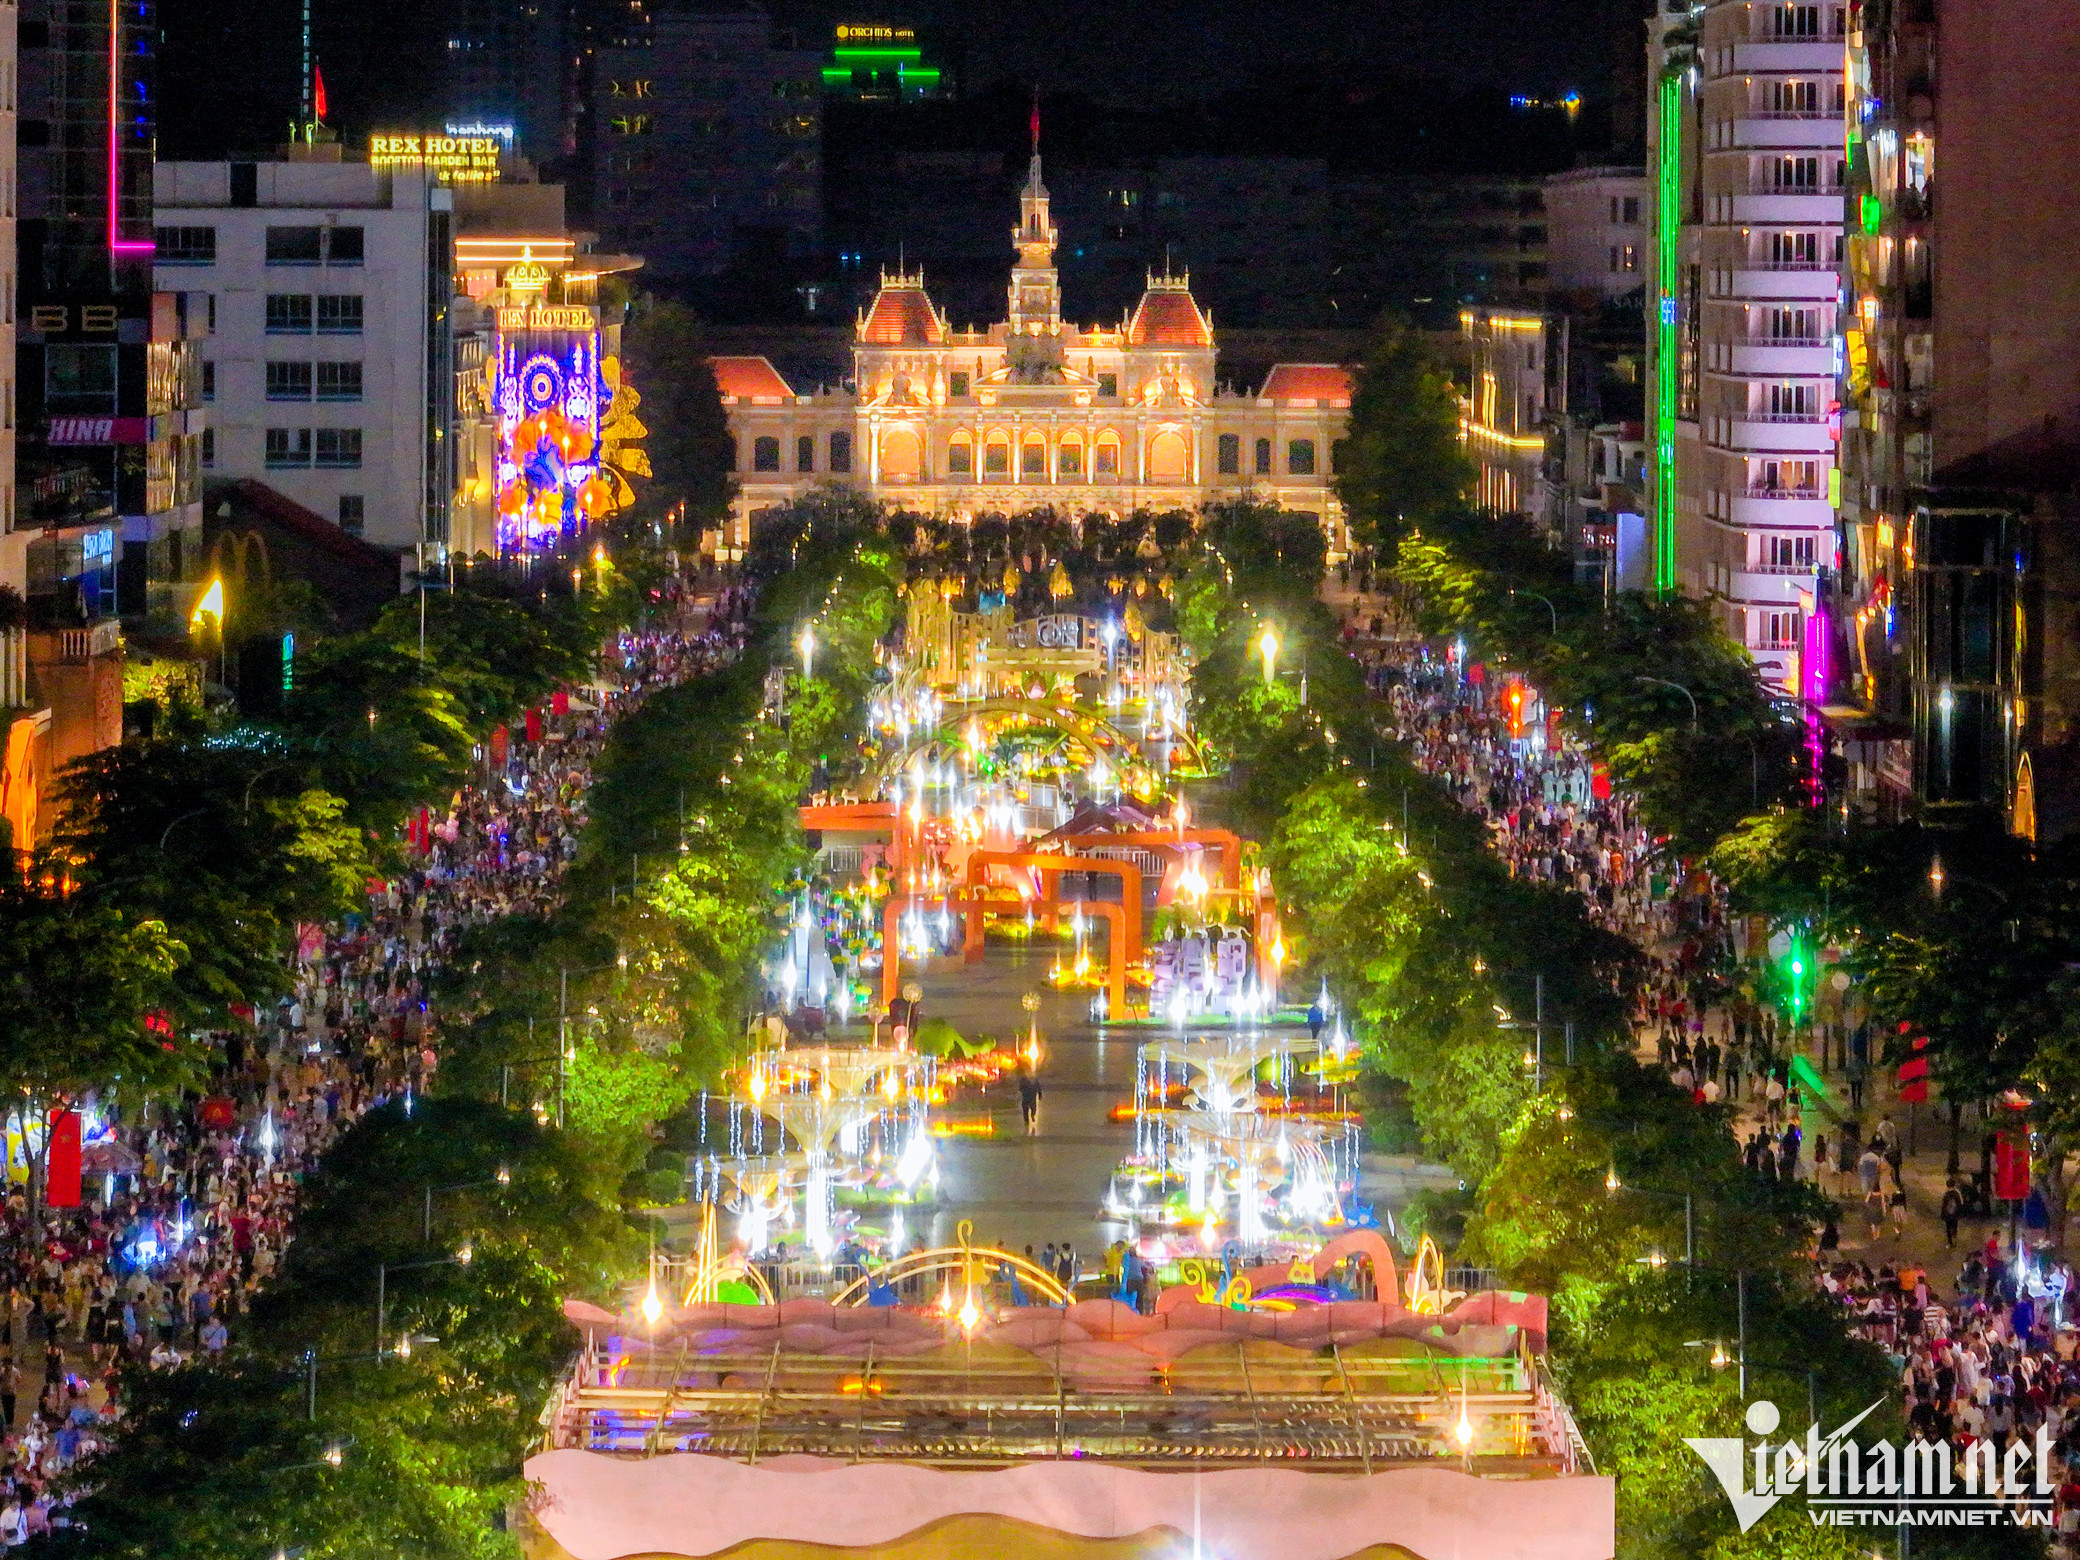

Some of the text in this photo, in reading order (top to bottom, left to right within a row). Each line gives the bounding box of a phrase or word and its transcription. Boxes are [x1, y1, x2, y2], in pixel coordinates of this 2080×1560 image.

[849, 27, 893, 37] ORCHIDS
[371, 137, 500, 154] REX HOTEL
[371, 155, 497, 167] ROOFTOP GARDEN BAR
[500, 308, 594, 328] REX HOTEL
